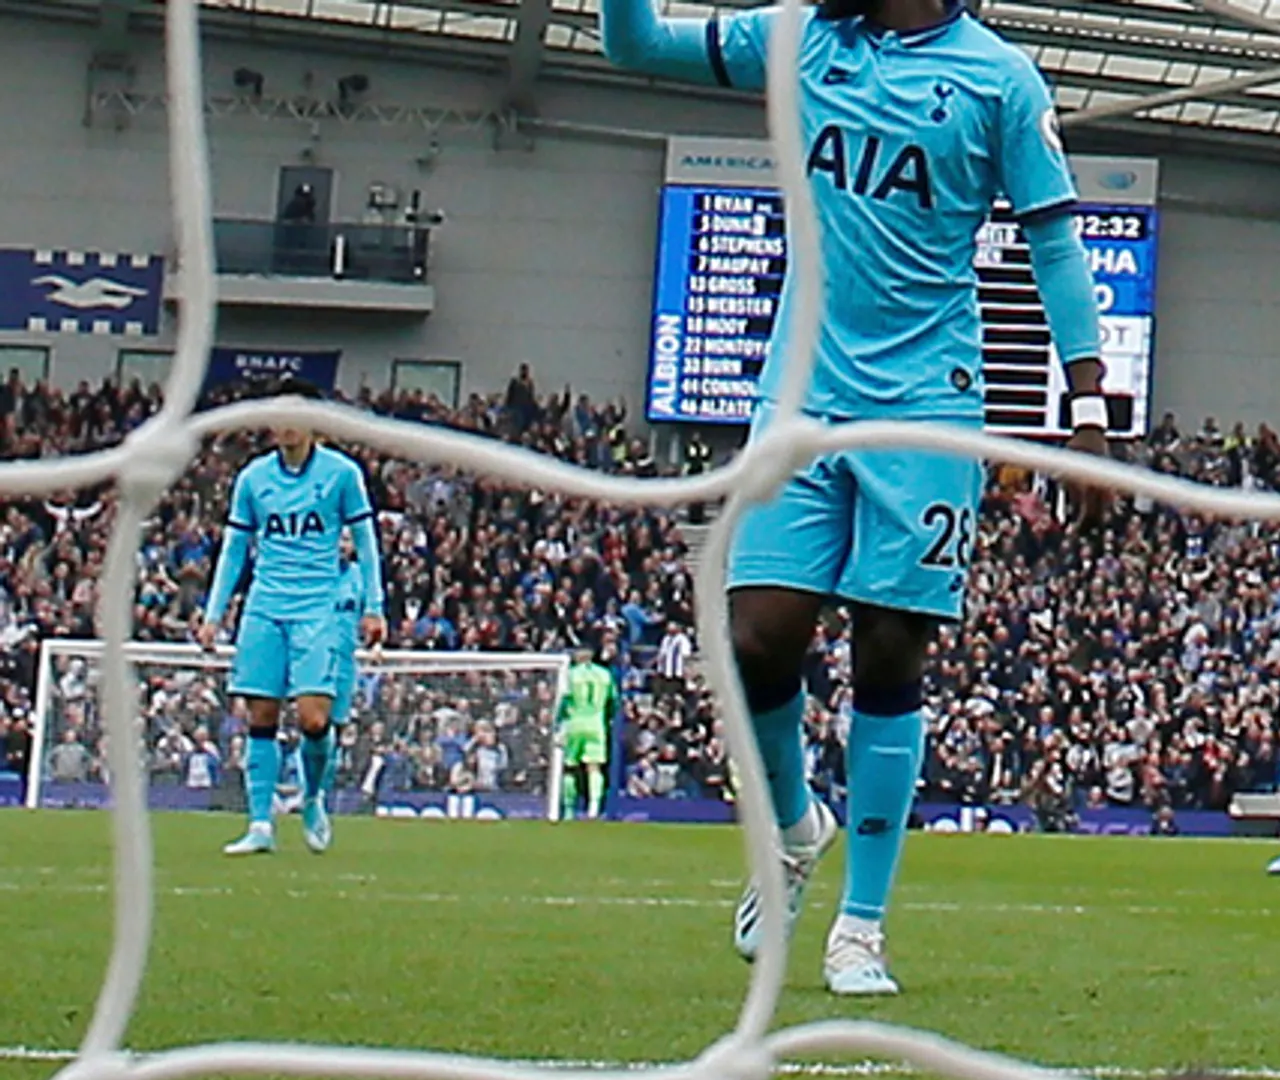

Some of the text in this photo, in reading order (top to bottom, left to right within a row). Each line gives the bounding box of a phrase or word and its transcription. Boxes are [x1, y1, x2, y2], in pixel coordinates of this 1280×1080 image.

[682, 155, 776, 169] AMERICA
[806, 123, 932, 209] AIA
[714, 195, 753, 212] RYAN
[711, 236, 783, 255] STEPHENS
[710, 257, 769, 274] MAUPAY
[1088, 247, 1137, 275] HA
[708, 276, 754, 294] GROSS
[707, 297, 772, 315] WEBSTER
[705, 318, 747, 335] MOOY
[650, 314, 681, 414] ALBION
[703, 357, 742, 375] BURN
[700, 399, 752, 418] ALZATE
[263, 511, 324, 538] AIA
